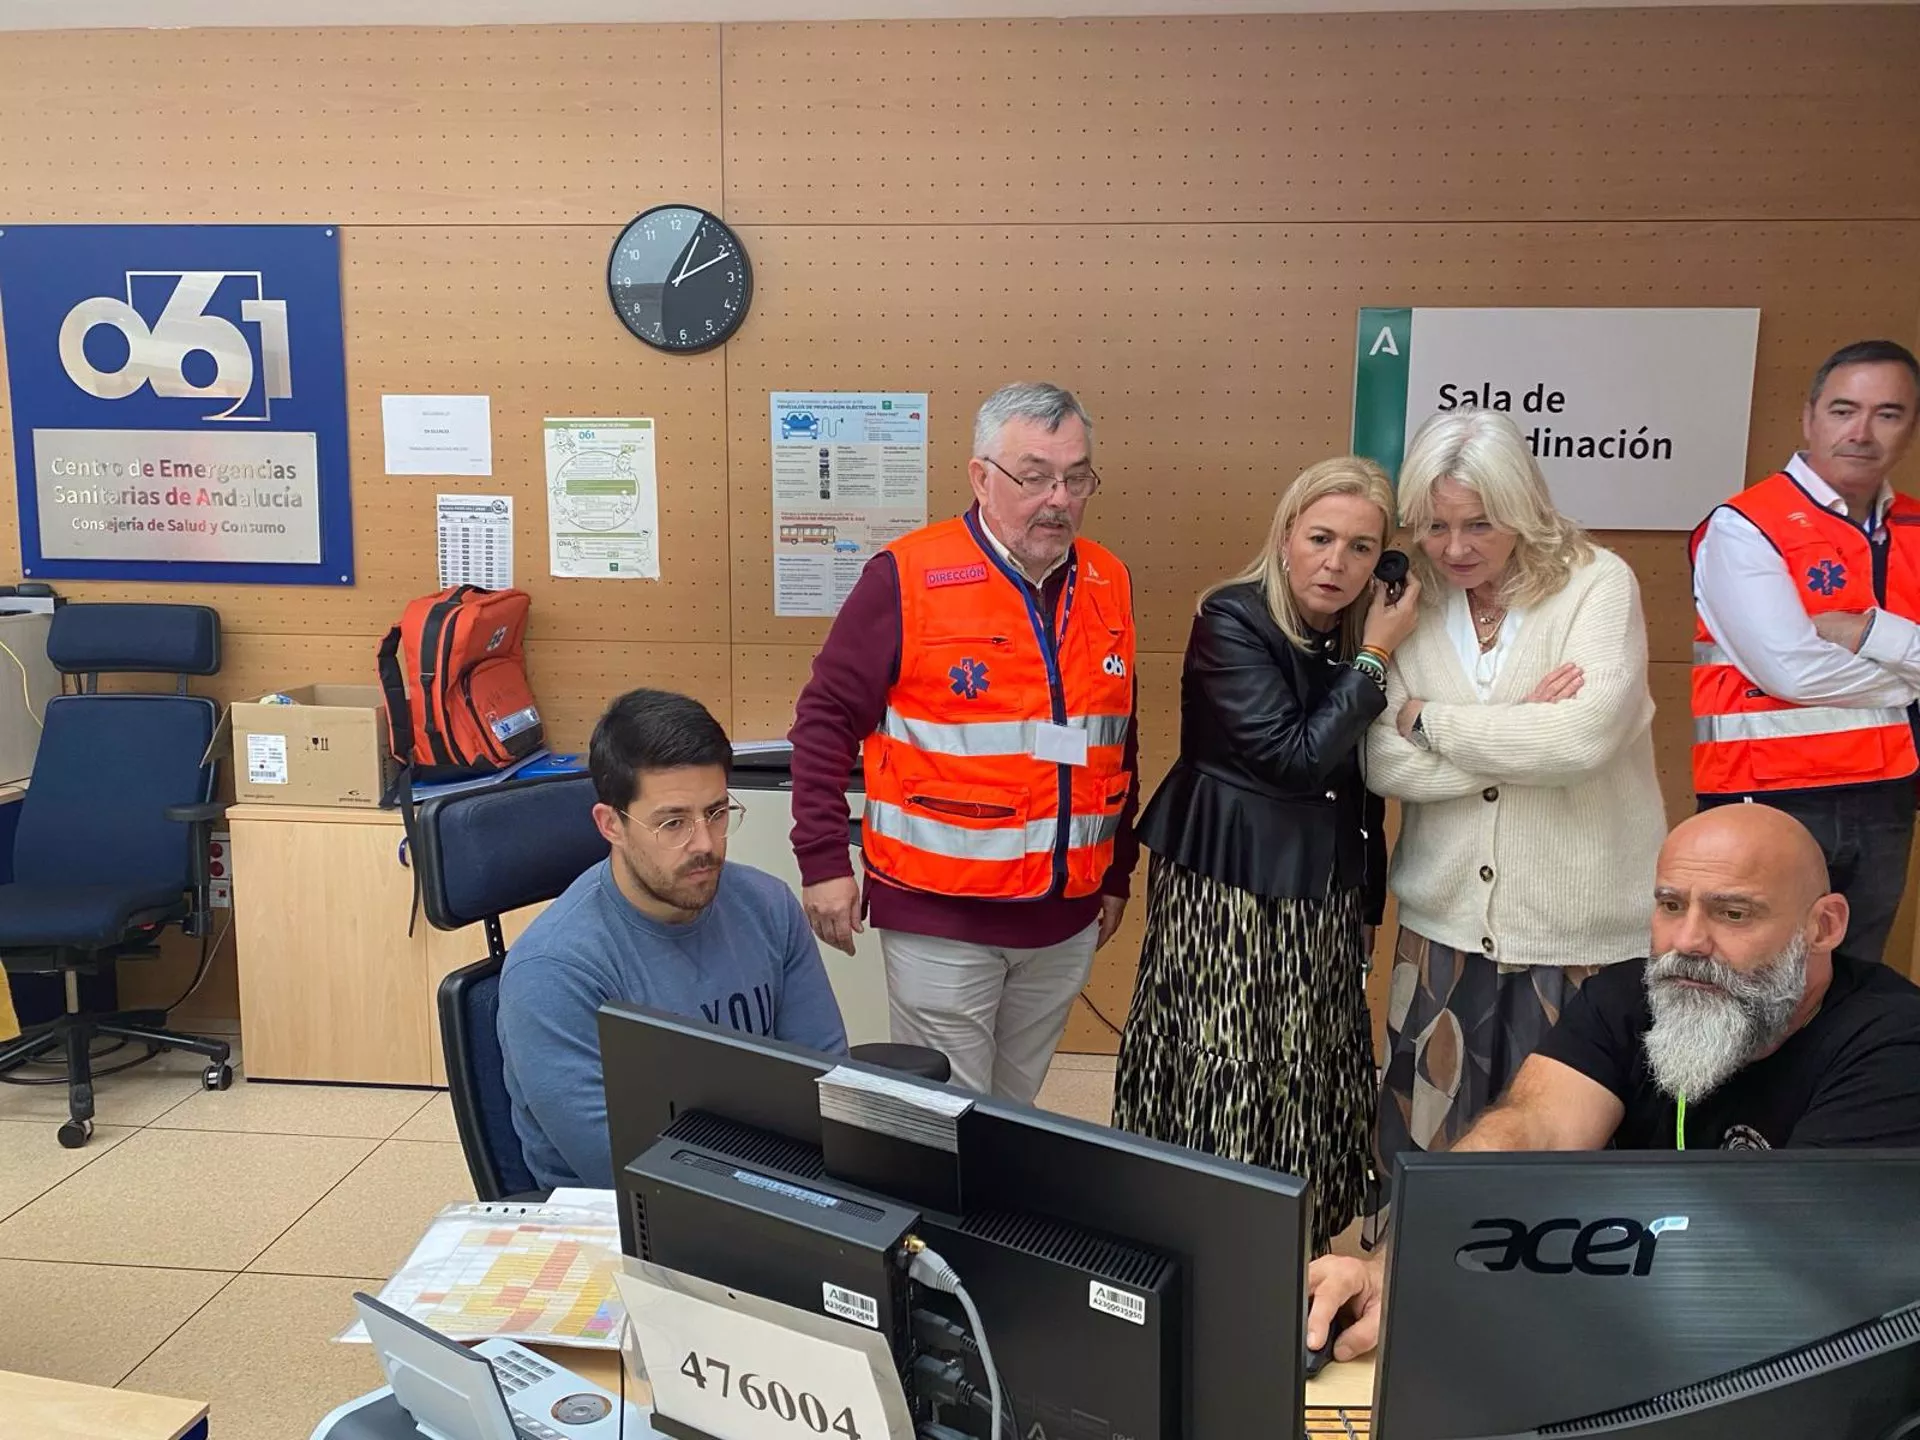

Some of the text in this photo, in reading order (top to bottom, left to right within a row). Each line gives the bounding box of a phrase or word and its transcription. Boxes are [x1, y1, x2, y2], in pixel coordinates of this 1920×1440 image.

[671, 220, 681, 231] 12
[646, 230, 656, 241] 11
[701, 227, 707, 238] 1
[629, 249, 640, 260] 10
[718, 245, 726, 257] 2
[623, 277, 631, 288] 9
[727, 272, 735, 283] 3
[634, 302, 641, 314] 8
[724, 299, 731, 309] 4
[653, 322, 661, 333] 7
[705, 320, 713, 331] 5
[679, 329, 687, 340] 6
[59, 271, 292, 420] 061
[1438, 382, 1566, 413] Sala de
[1526, 426, 1672, 459] dinación
[51, 457, 296, 483] Centro de Emergencias
[54, 485, 303, 507] Sanitarias de Andalucía
[72, 517, 286, 535] Consejería de Salud y Consumo
[928, 566, 985, 584] DIRECCIÓN
[1454, 1216, 1689, 1277] acer
[680, 1351, 860, 1440] 476004
